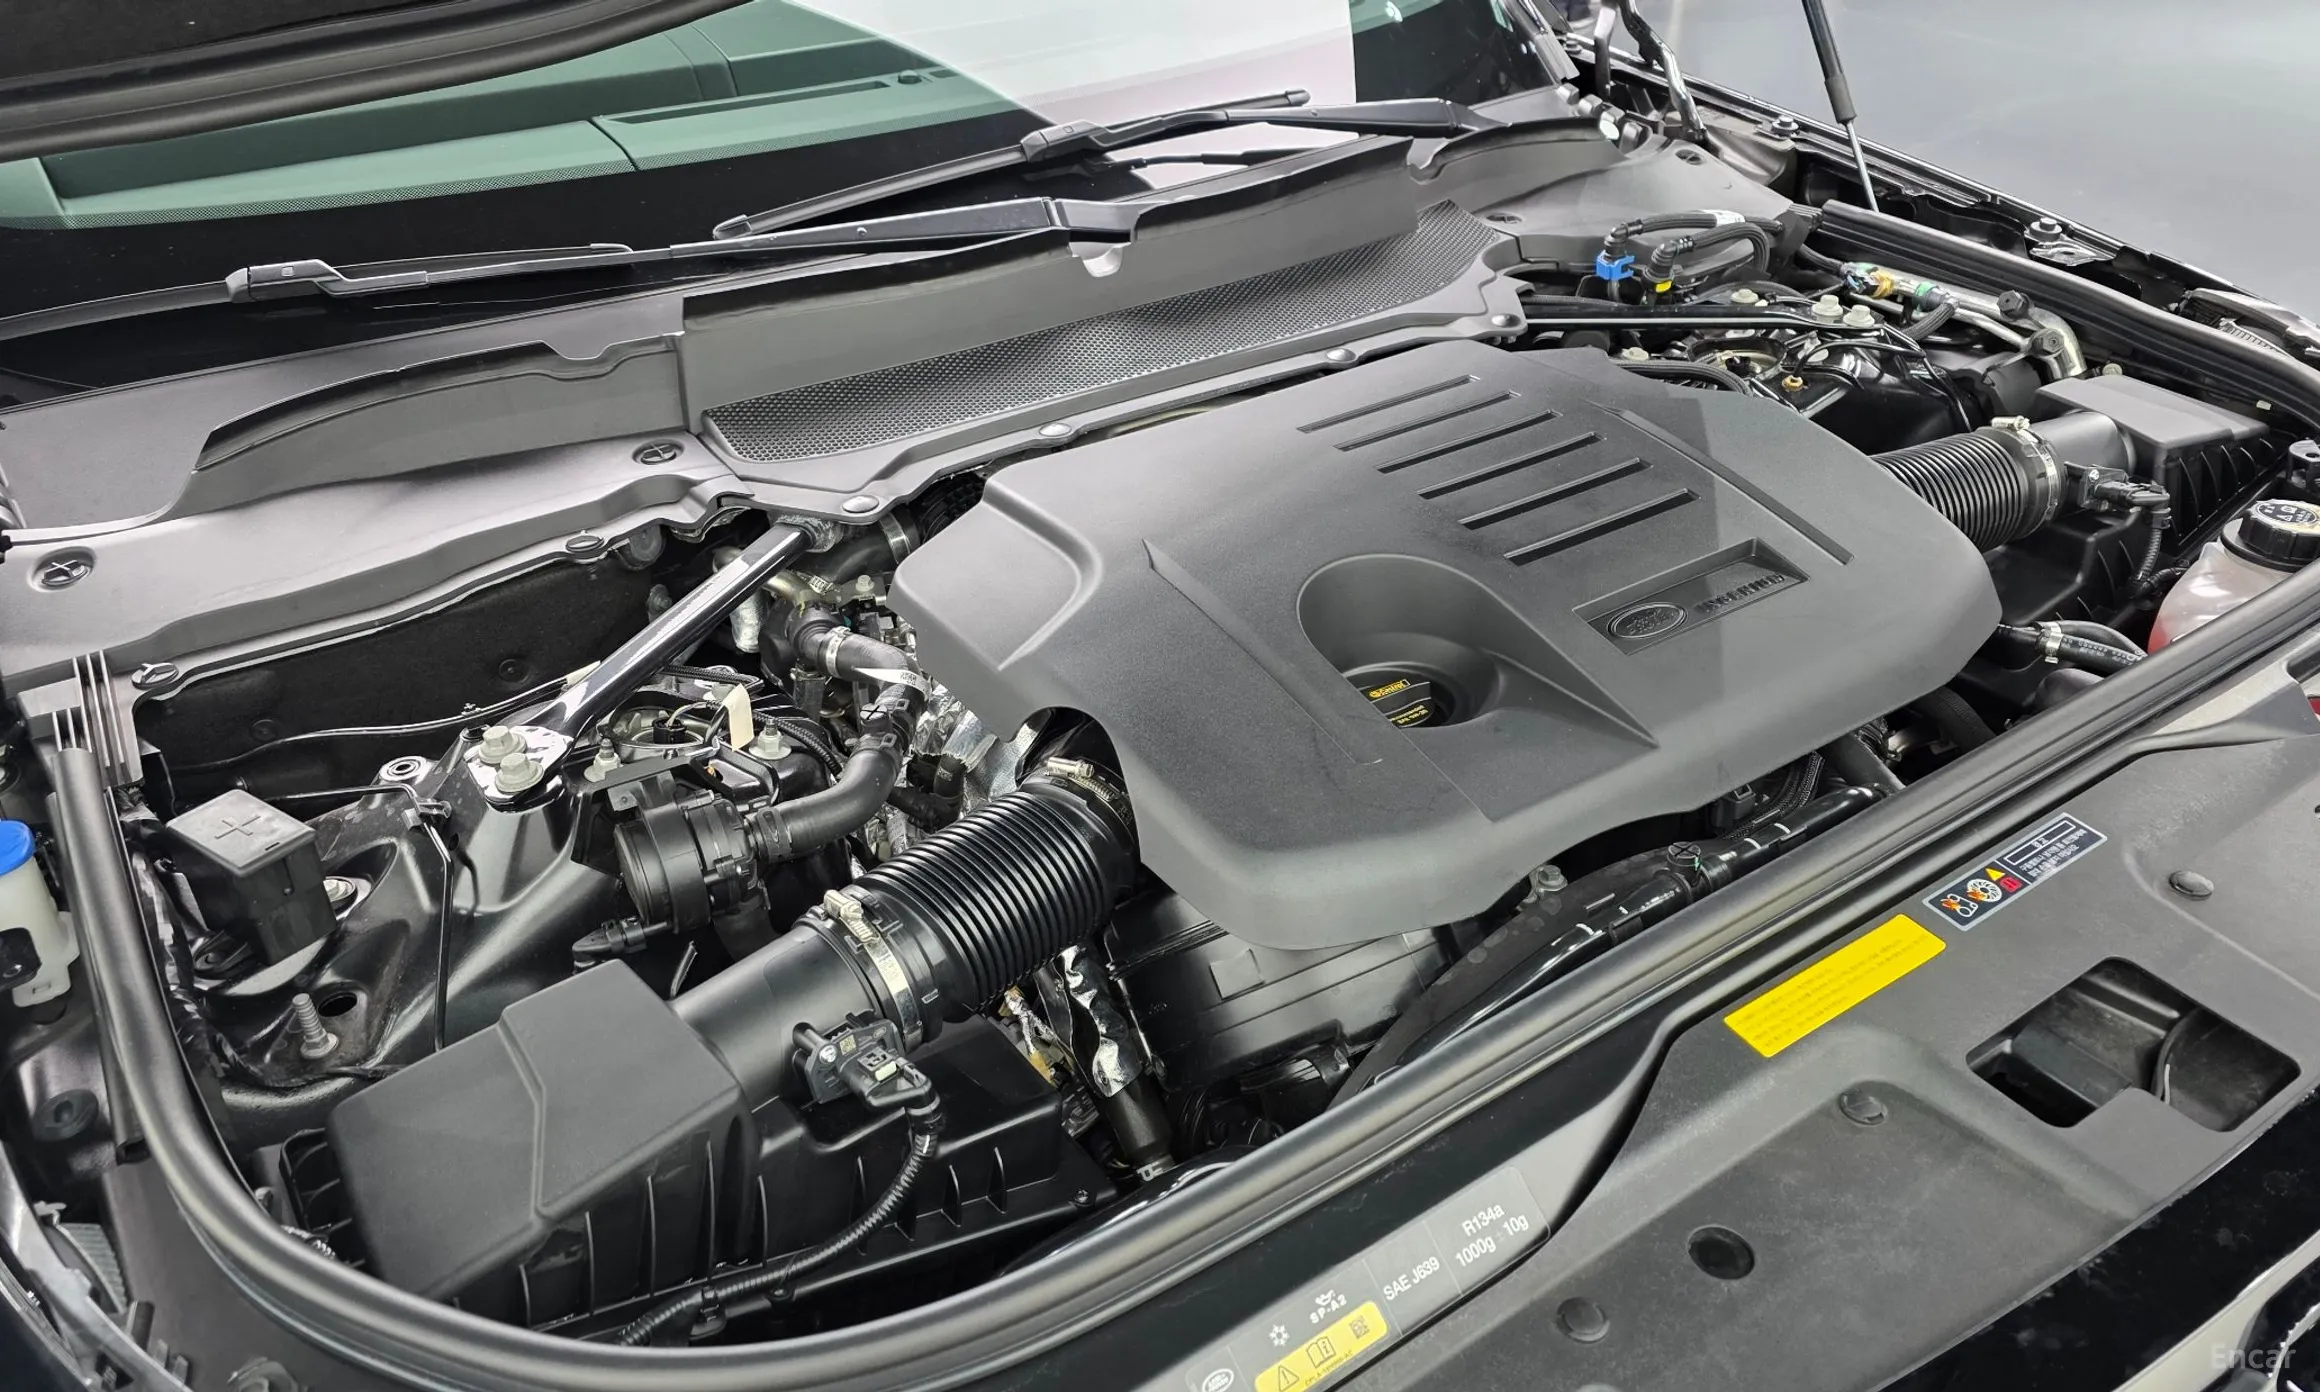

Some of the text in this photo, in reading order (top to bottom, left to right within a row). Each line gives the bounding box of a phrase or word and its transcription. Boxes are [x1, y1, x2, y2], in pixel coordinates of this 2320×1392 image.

[1455, 1236, 1497, 1267] 1000g
[1502, 1214, 1530, 1236] 10g
[1462, 1204, 1506, 1237] R134a
[1383, 1256, 1441, 1301] SAE J639
